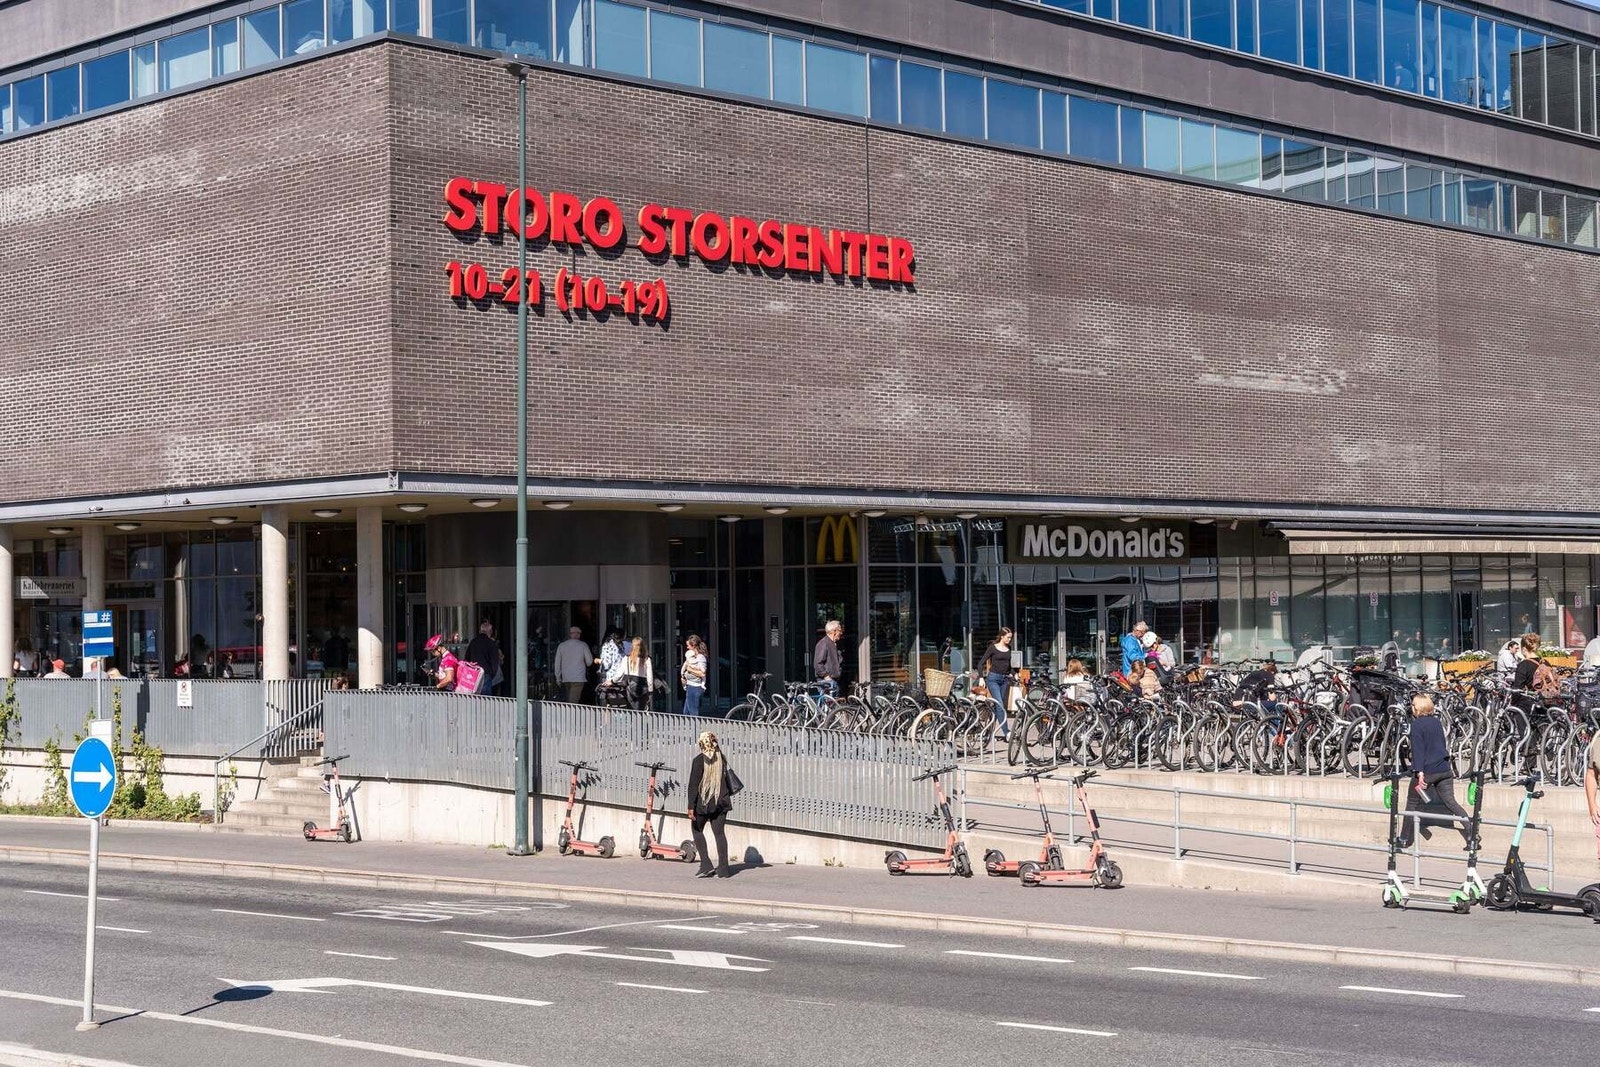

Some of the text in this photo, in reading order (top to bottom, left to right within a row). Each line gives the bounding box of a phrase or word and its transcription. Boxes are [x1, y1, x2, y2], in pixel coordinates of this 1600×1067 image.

[443, 176, 915, 284] STORO STORSENTER
[444, 261, 669, 320] 10-21 (10-19)
[1023, 524, 1185, 558] McDonald's
